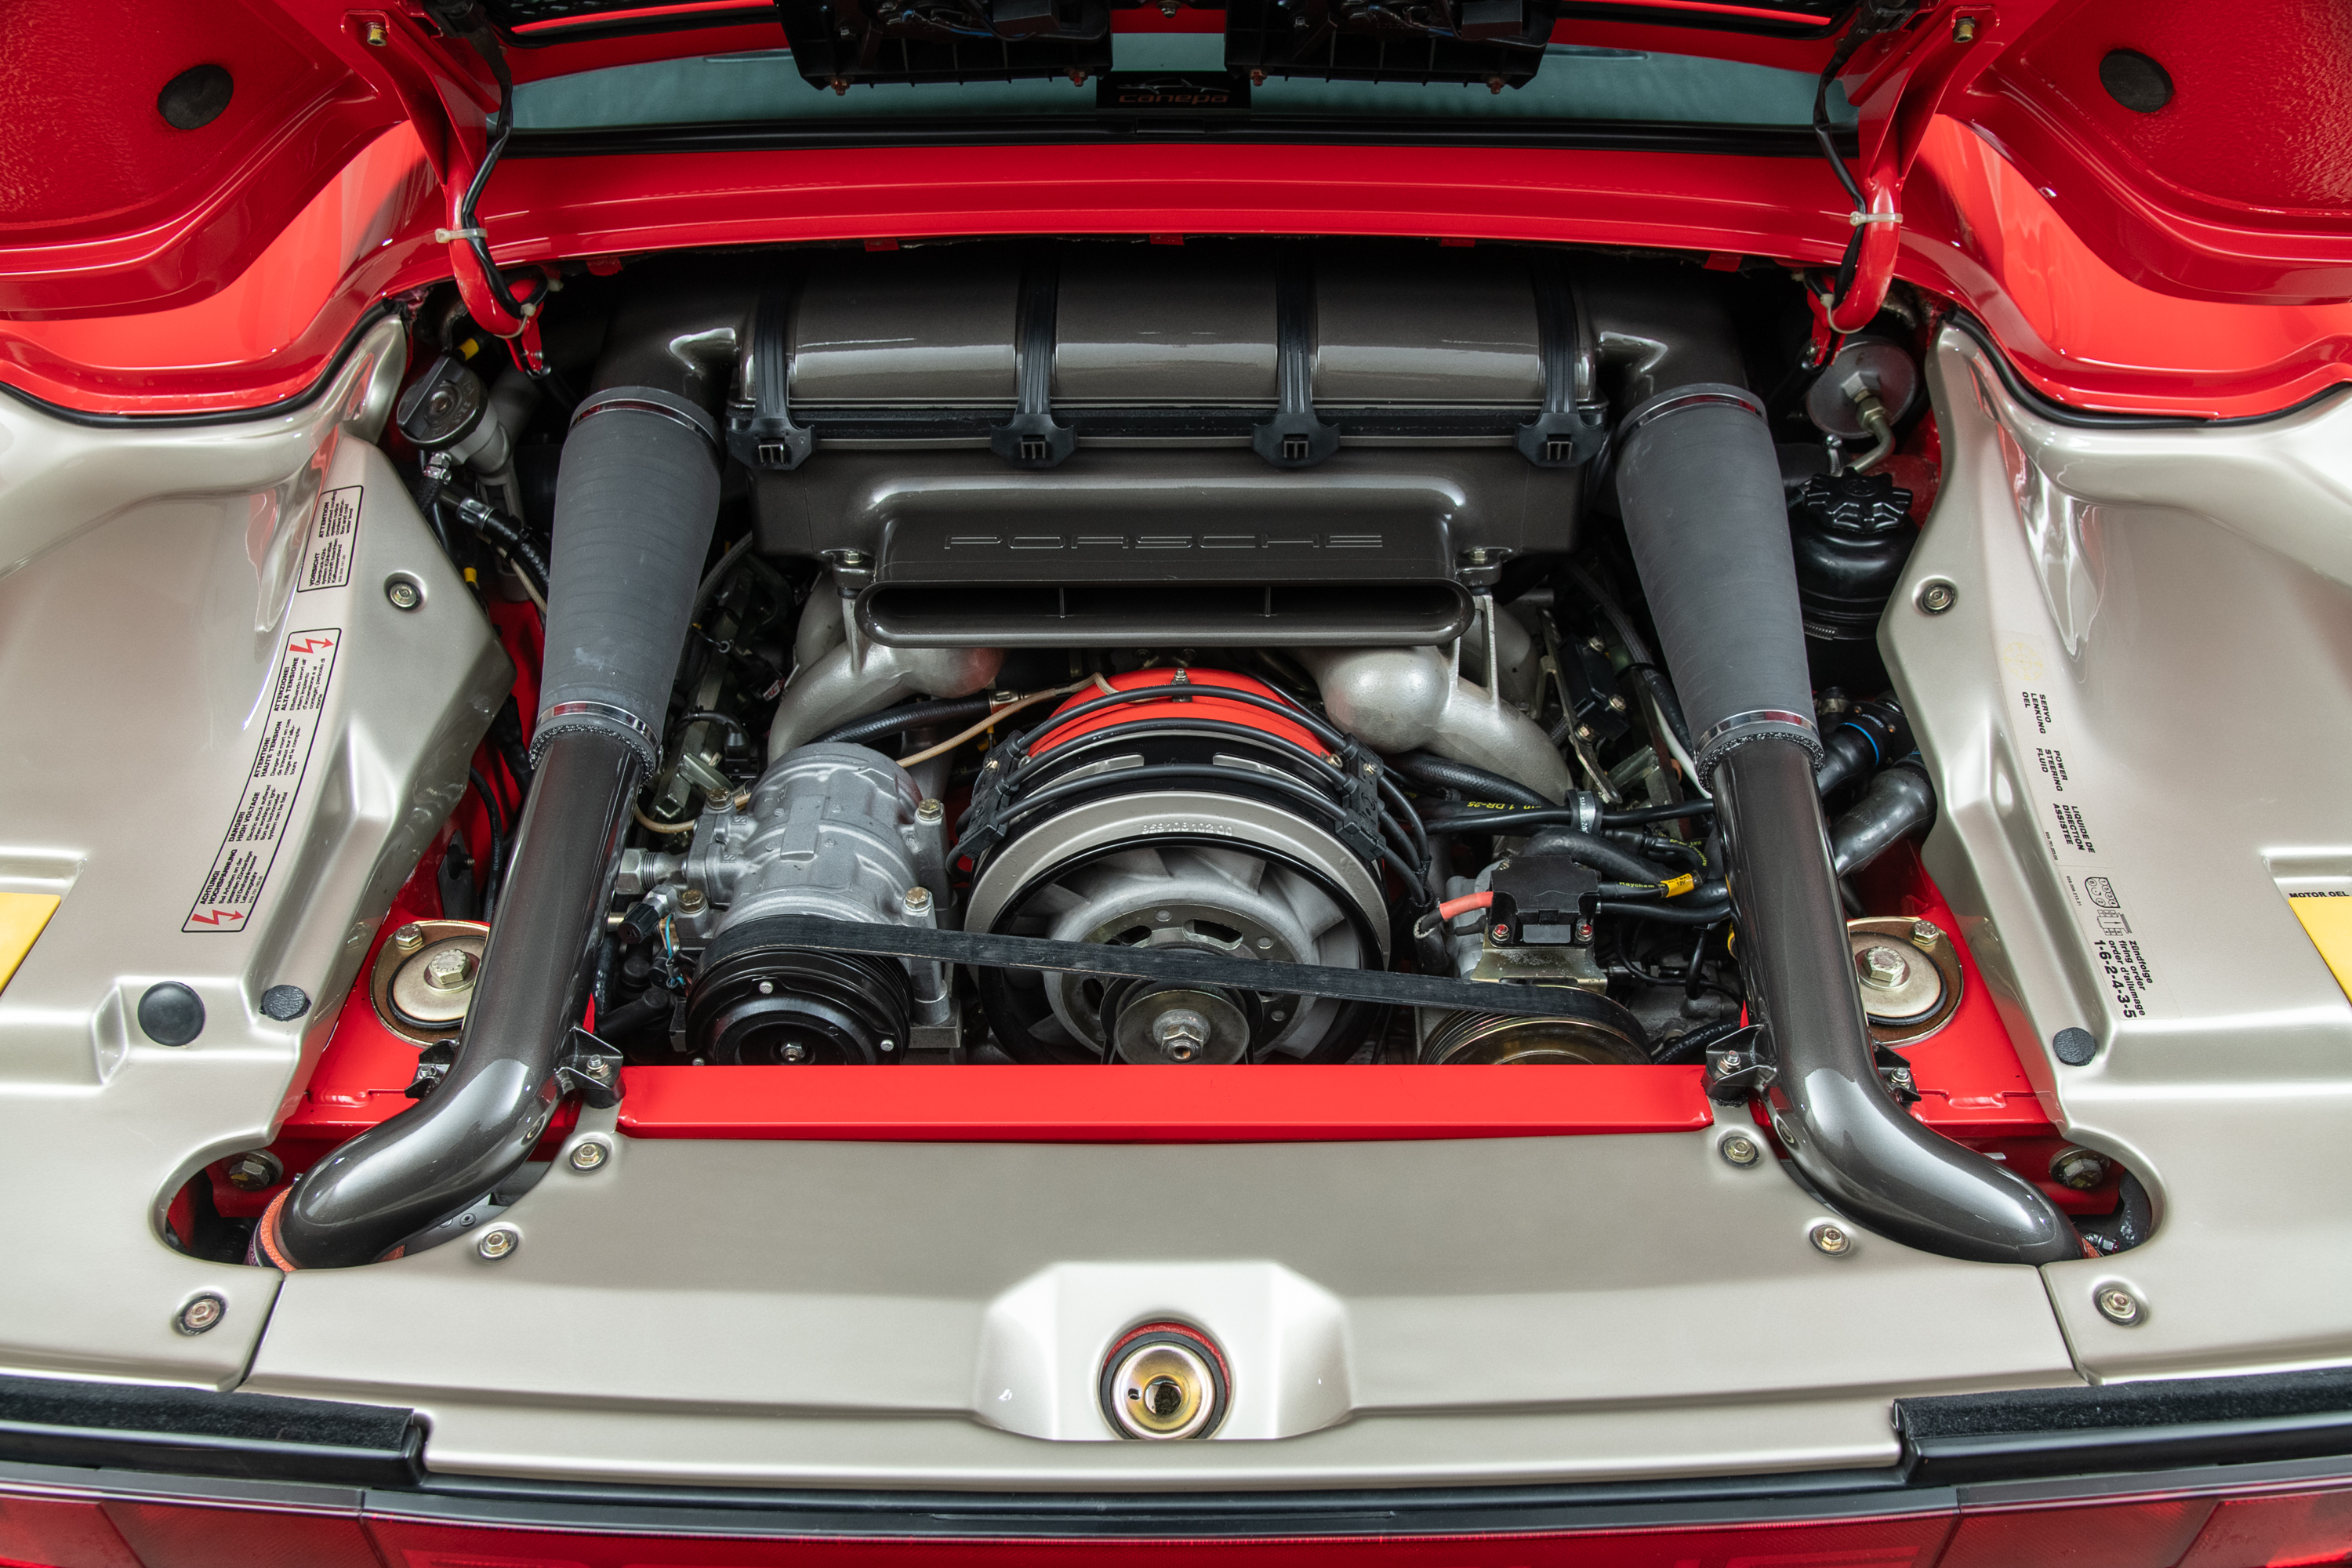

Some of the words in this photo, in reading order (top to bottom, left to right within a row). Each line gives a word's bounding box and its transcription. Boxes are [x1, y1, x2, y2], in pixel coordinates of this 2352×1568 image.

[1119, 94, 1229, 105] canepa
[318, 501, 330, 538] ATTENTION
[330, 538, 339, 561] beachten
[944, 534, 1383, 550] PORSCHE
[309, 552, 321, 586] VORSICHT
[274, 666, 290, 712] ATTENZIONE!
[285, 657, 299, 693] TENSIONE
[296, 695, 304, 710] intero
[300, 672, 310, 695] impianto
[315, 663, 325, 685] pericolo
[281, 694, 290, 711] ALTA
[2022, 691, 2031, 709] OEL
[2031, 692, 2046, 735] LENKUNG
[2039, 694, 2052, 724] SERVO
[253, 737, 271, 778] ATTENTION!
[260, 753, 273, 778] HAUTE
[268, 720, 282, 753] TENSION
[270, 757, 280, 777] Danger
[278, 749, 289, 768] travaux
[283, 760, 292, 775] mage
[292, 726, 301, 748] compte-
[2035, 747, 2049, 773] FLUID
[2053, 750, 2068, 781] POWER
[289, 761, 298, 775] tours
[2045, 749, 2063, 792] STEERING
[235, 824, 249, 842] HIGH
[243, 792, 260, 823] VOLTAGE
[245, 822, 258, 841] Electric
[255, 805, 264, 822] shock
[260, 784, 272, 805] suffered
[253, 827, 263, 841] when
[259, 807, 270, 827] working
[260, 830, 268, 840] tion
[267, 793, 281, 822] tachometer
[267, 821, 278, 840] system
[279, 791, 289, 804] fatal
[1466, 801, 1506, 811] DR-25
[2053, 803, 2074, 845] ASSISTEE
[227, 811, 245, 842] DANGER!
[2062, 804, 2085, 851] DIRECTION
[2071, 805, 2090, 840] LIQUIDE
[2085, 841, 2096, 854] DE
[199, 870, 221, 905] ACHTUNG!
[207, 848, 238, 905] HOCHSPANNUNG
[218, 895, 227, 904] Bei
[223, 873, 237, 895] Arbeiten
[227, 880, 241, 904] gesamten
[236, 851, 253, 880] Zündanlage
[237, 855, 258, 895] Drehzahlmesser
[239, 871, 258, 904] Lebensgefahr
[2093, 939, 2137, 1018] 1-6-2-4-3-5
[2108, 940, 2125, 965] order
[2119, 967, 2146, 1016] d'allumage
[2118, 939, 2134, 964] firing
[2129, 965, 2146, 991] order
[2128, 940, 2154, 984] Zündfolge
